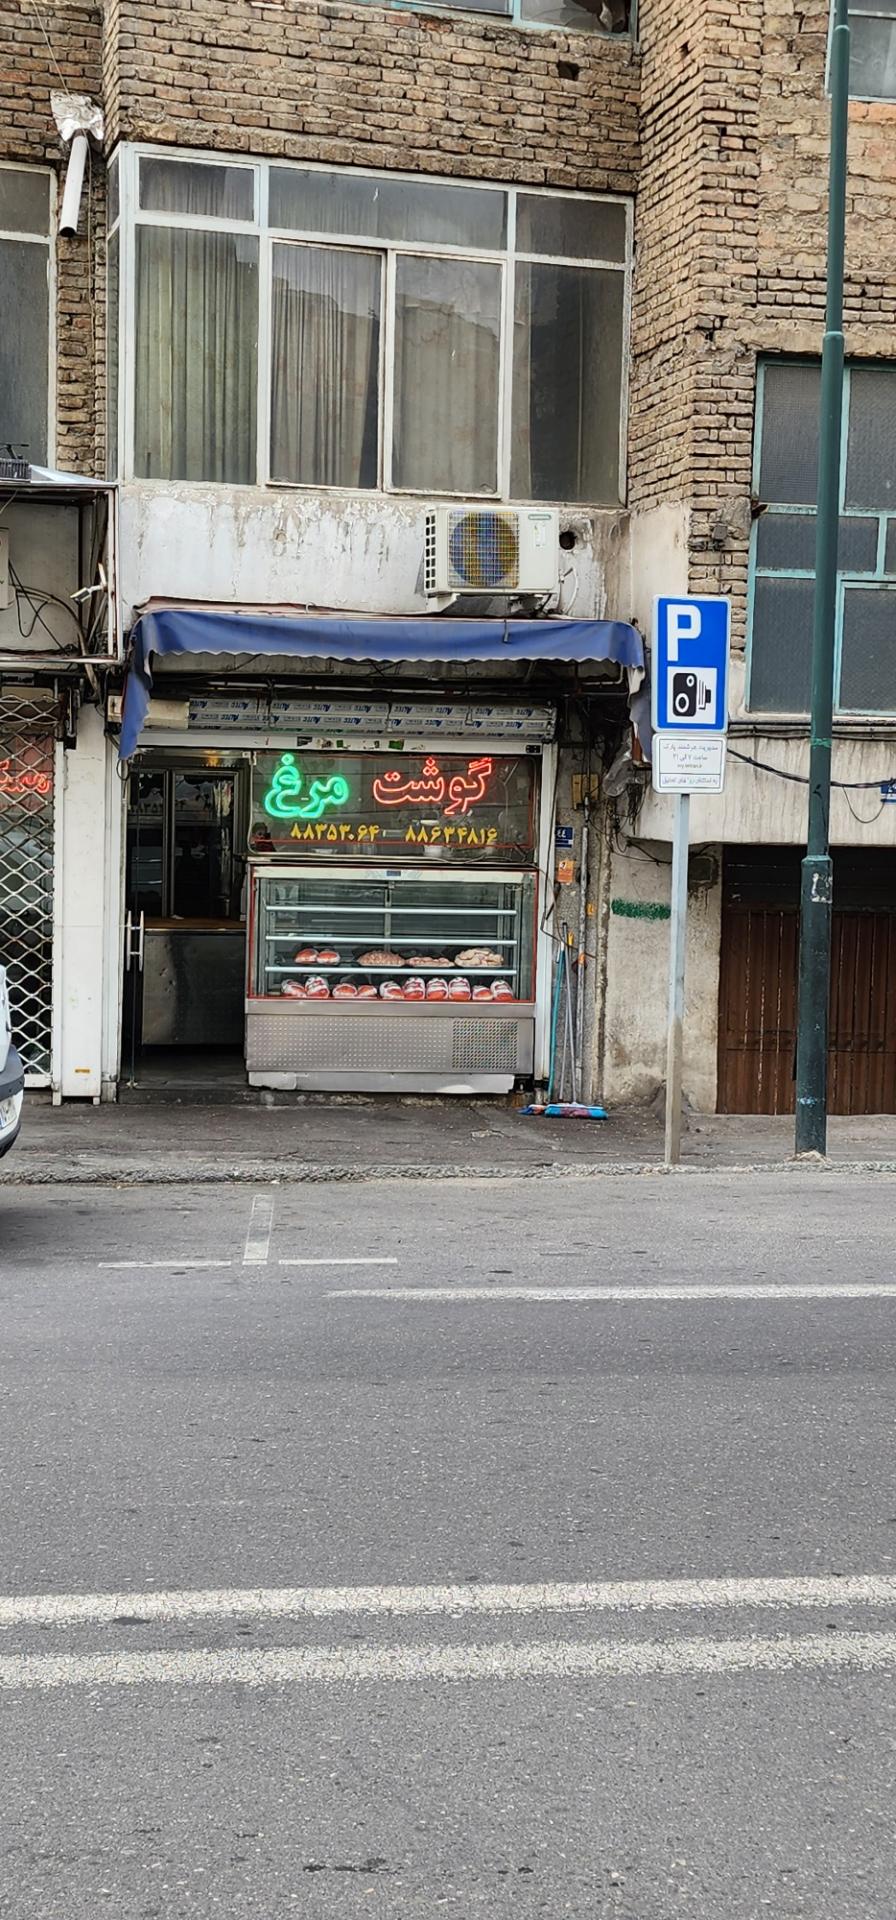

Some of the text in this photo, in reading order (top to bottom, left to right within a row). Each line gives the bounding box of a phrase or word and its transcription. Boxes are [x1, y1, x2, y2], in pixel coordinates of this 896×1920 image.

[667, 604, 702, 662] P
[265, 753, 492, 818] گوشت مرغ
[290, 822, 498, 845] ۸۸۶۳۴۸۱۶ ۸۸۳۵۳۰۶۴
